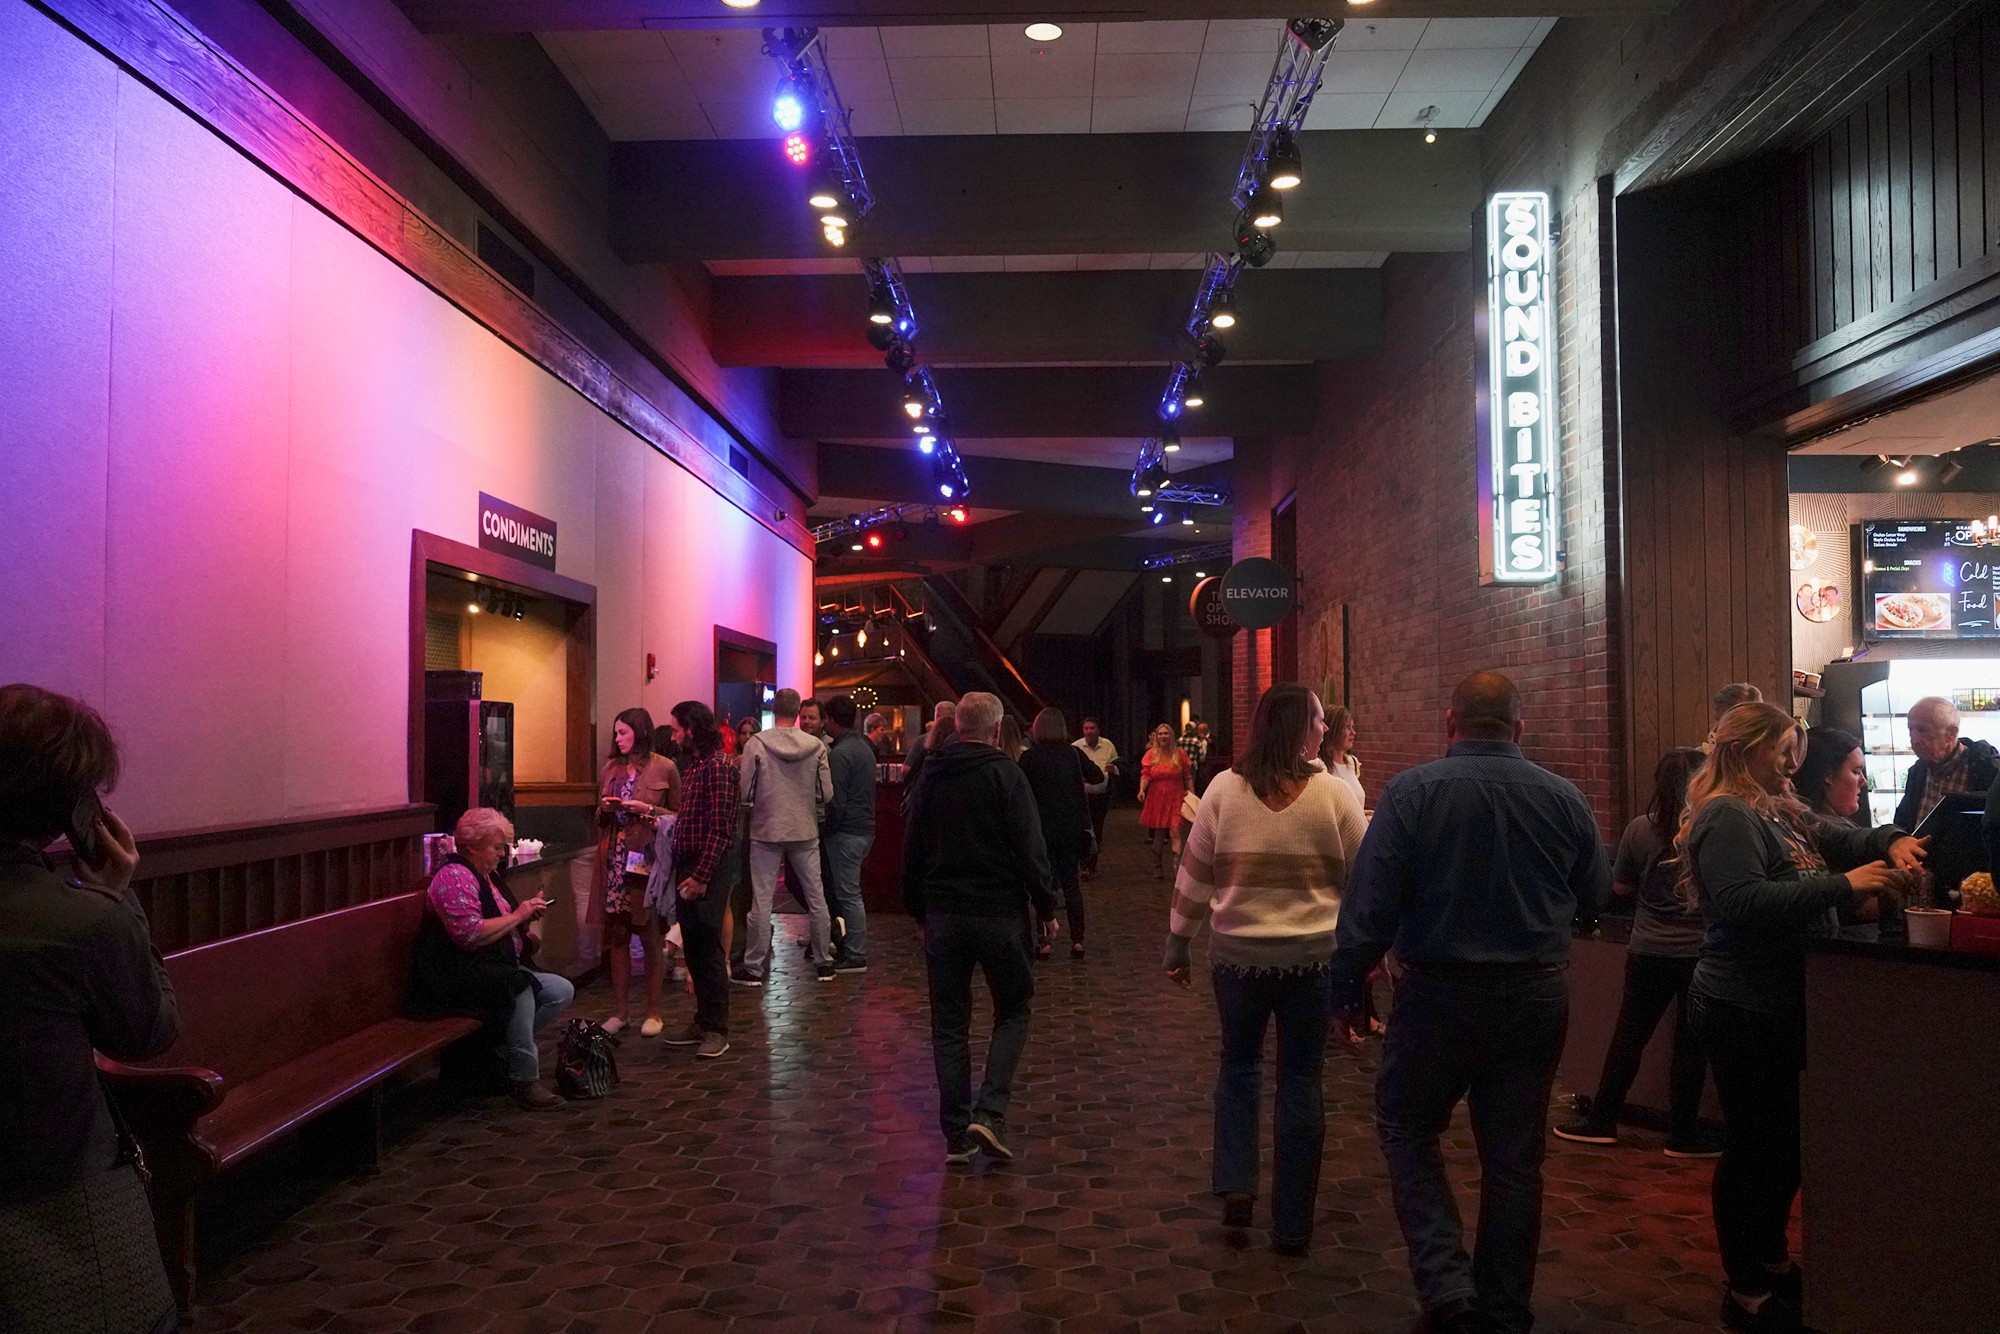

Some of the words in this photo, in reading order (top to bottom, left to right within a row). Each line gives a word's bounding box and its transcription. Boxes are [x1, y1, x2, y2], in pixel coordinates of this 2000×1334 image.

[1502, 196, 1541, 377] SOUND
[1508, 391, 1543, 571] BITES
[482, 509, 554, 557] CONDIMENTS
[1960, 561, 1989, 582] Cold
[1226, 588, 1288, 599] ELEVATOR
[1958, 590, 1988, 612] Food
